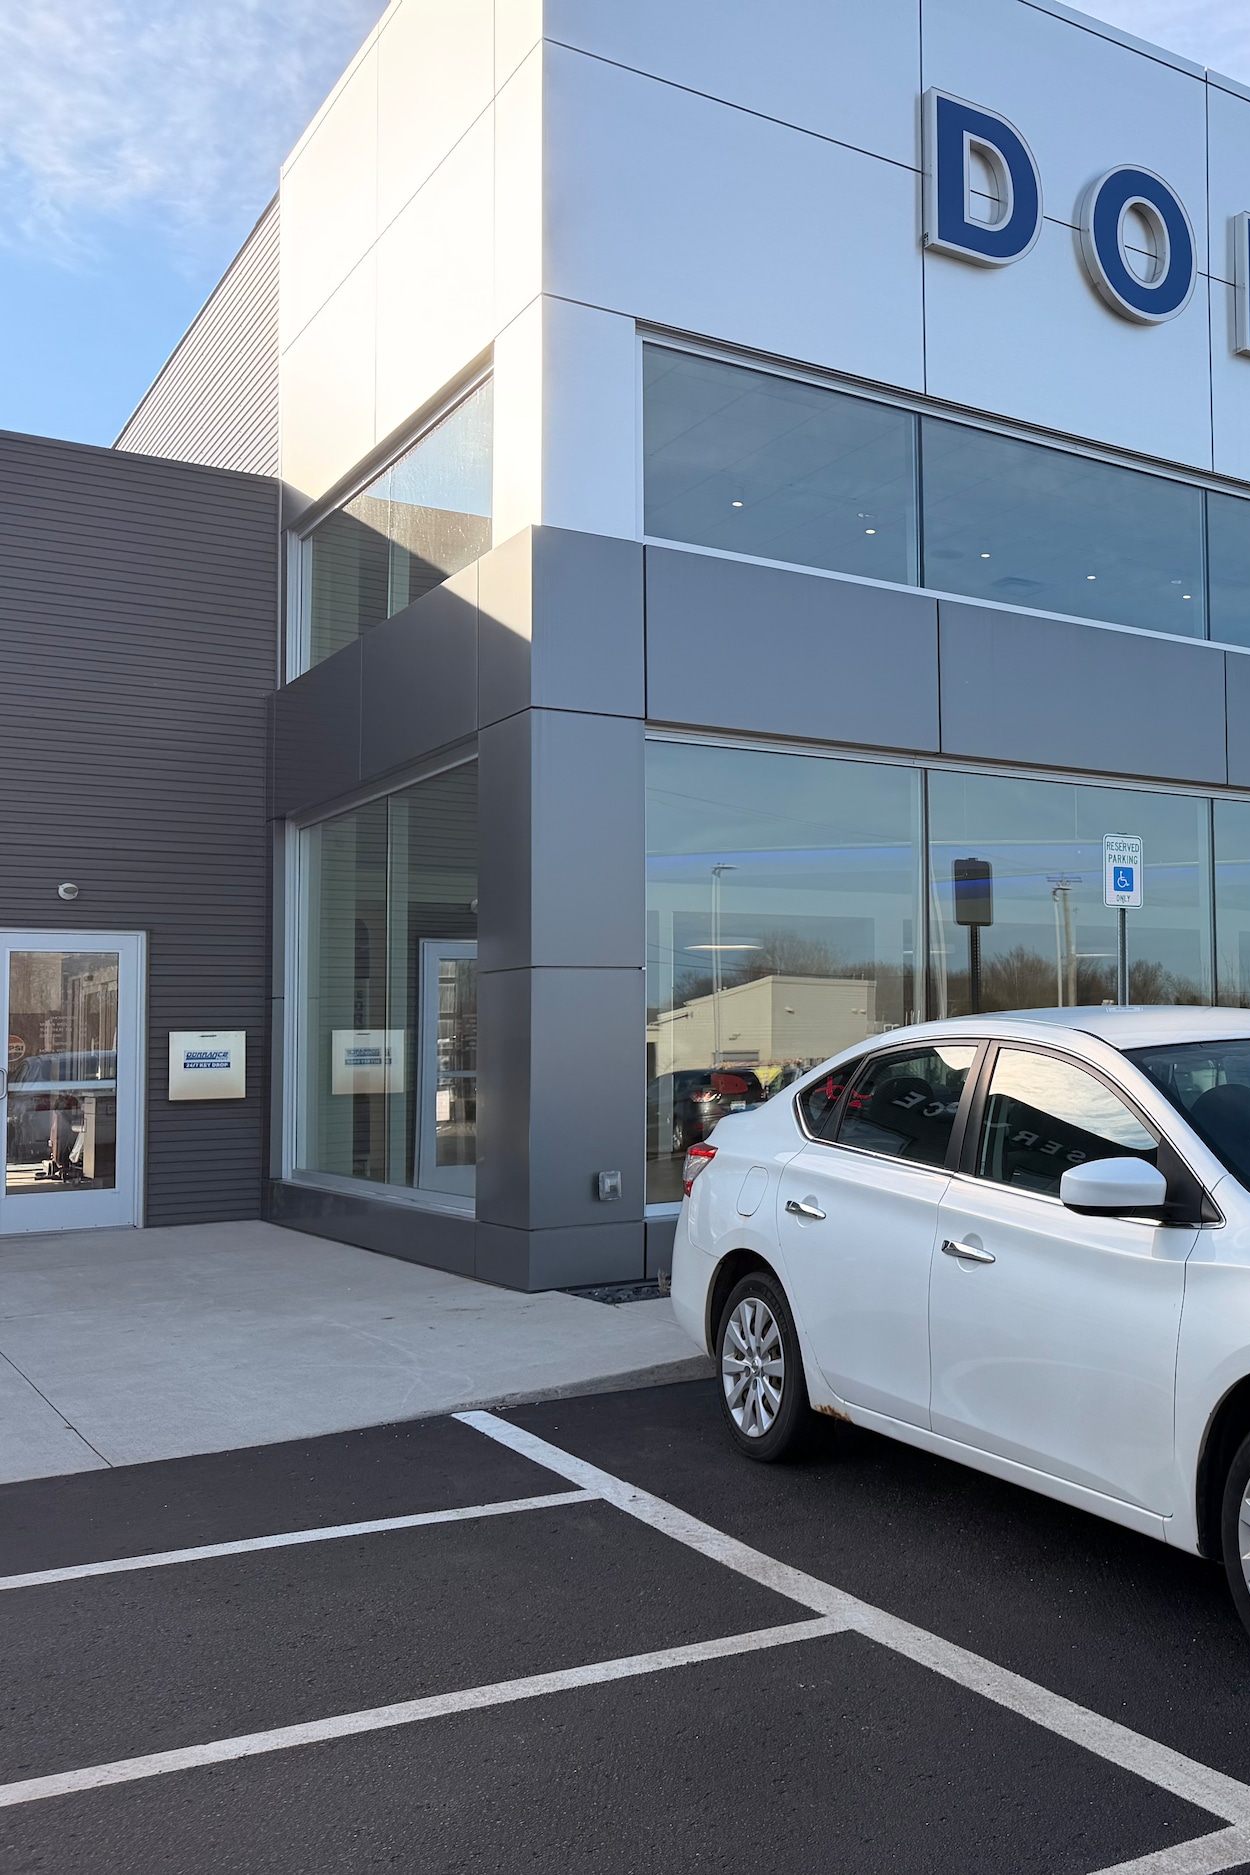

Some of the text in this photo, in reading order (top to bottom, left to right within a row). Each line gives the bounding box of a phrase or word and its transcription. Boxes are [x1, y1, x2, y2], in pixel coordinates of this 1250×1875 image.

[1106, 841, 1140, 853] RESERVED
[1108, 853, 1138, 865] PARKING
[1116, 894, 1131, 903] ONLY
